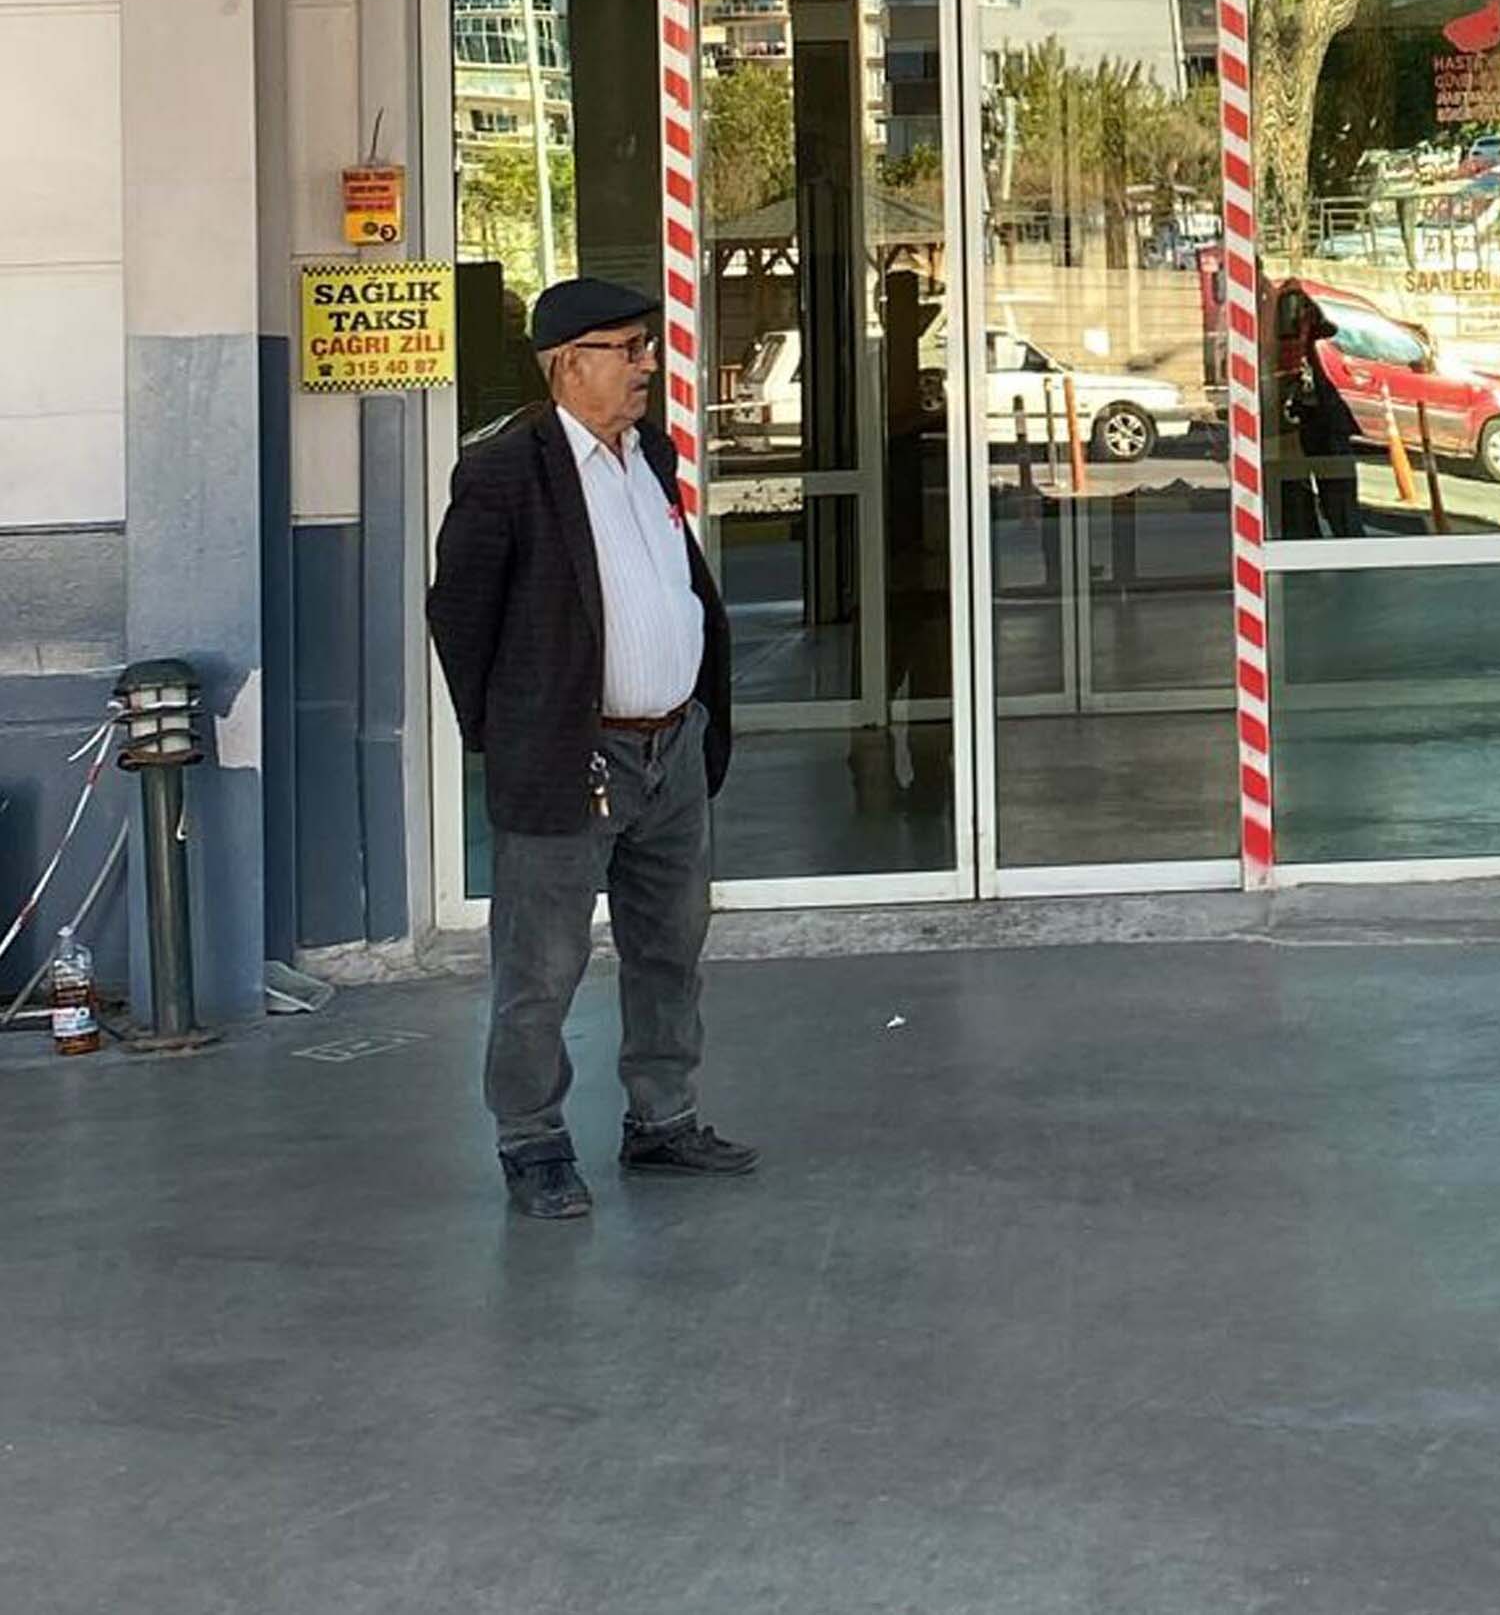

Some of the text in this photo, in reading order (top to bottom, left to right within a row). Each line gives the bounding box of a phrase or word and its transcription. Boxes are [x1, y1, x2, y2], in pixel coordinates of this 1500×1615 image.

[314, 276, 441, 305] SAĞLIK
[328, 302, 428, 333] TAKSİ
[311, 329, 444, 360] ÇAĞRI ZİLİ
[344, 360, 380, 377] 315
[386, 359, 408, 375] 40
